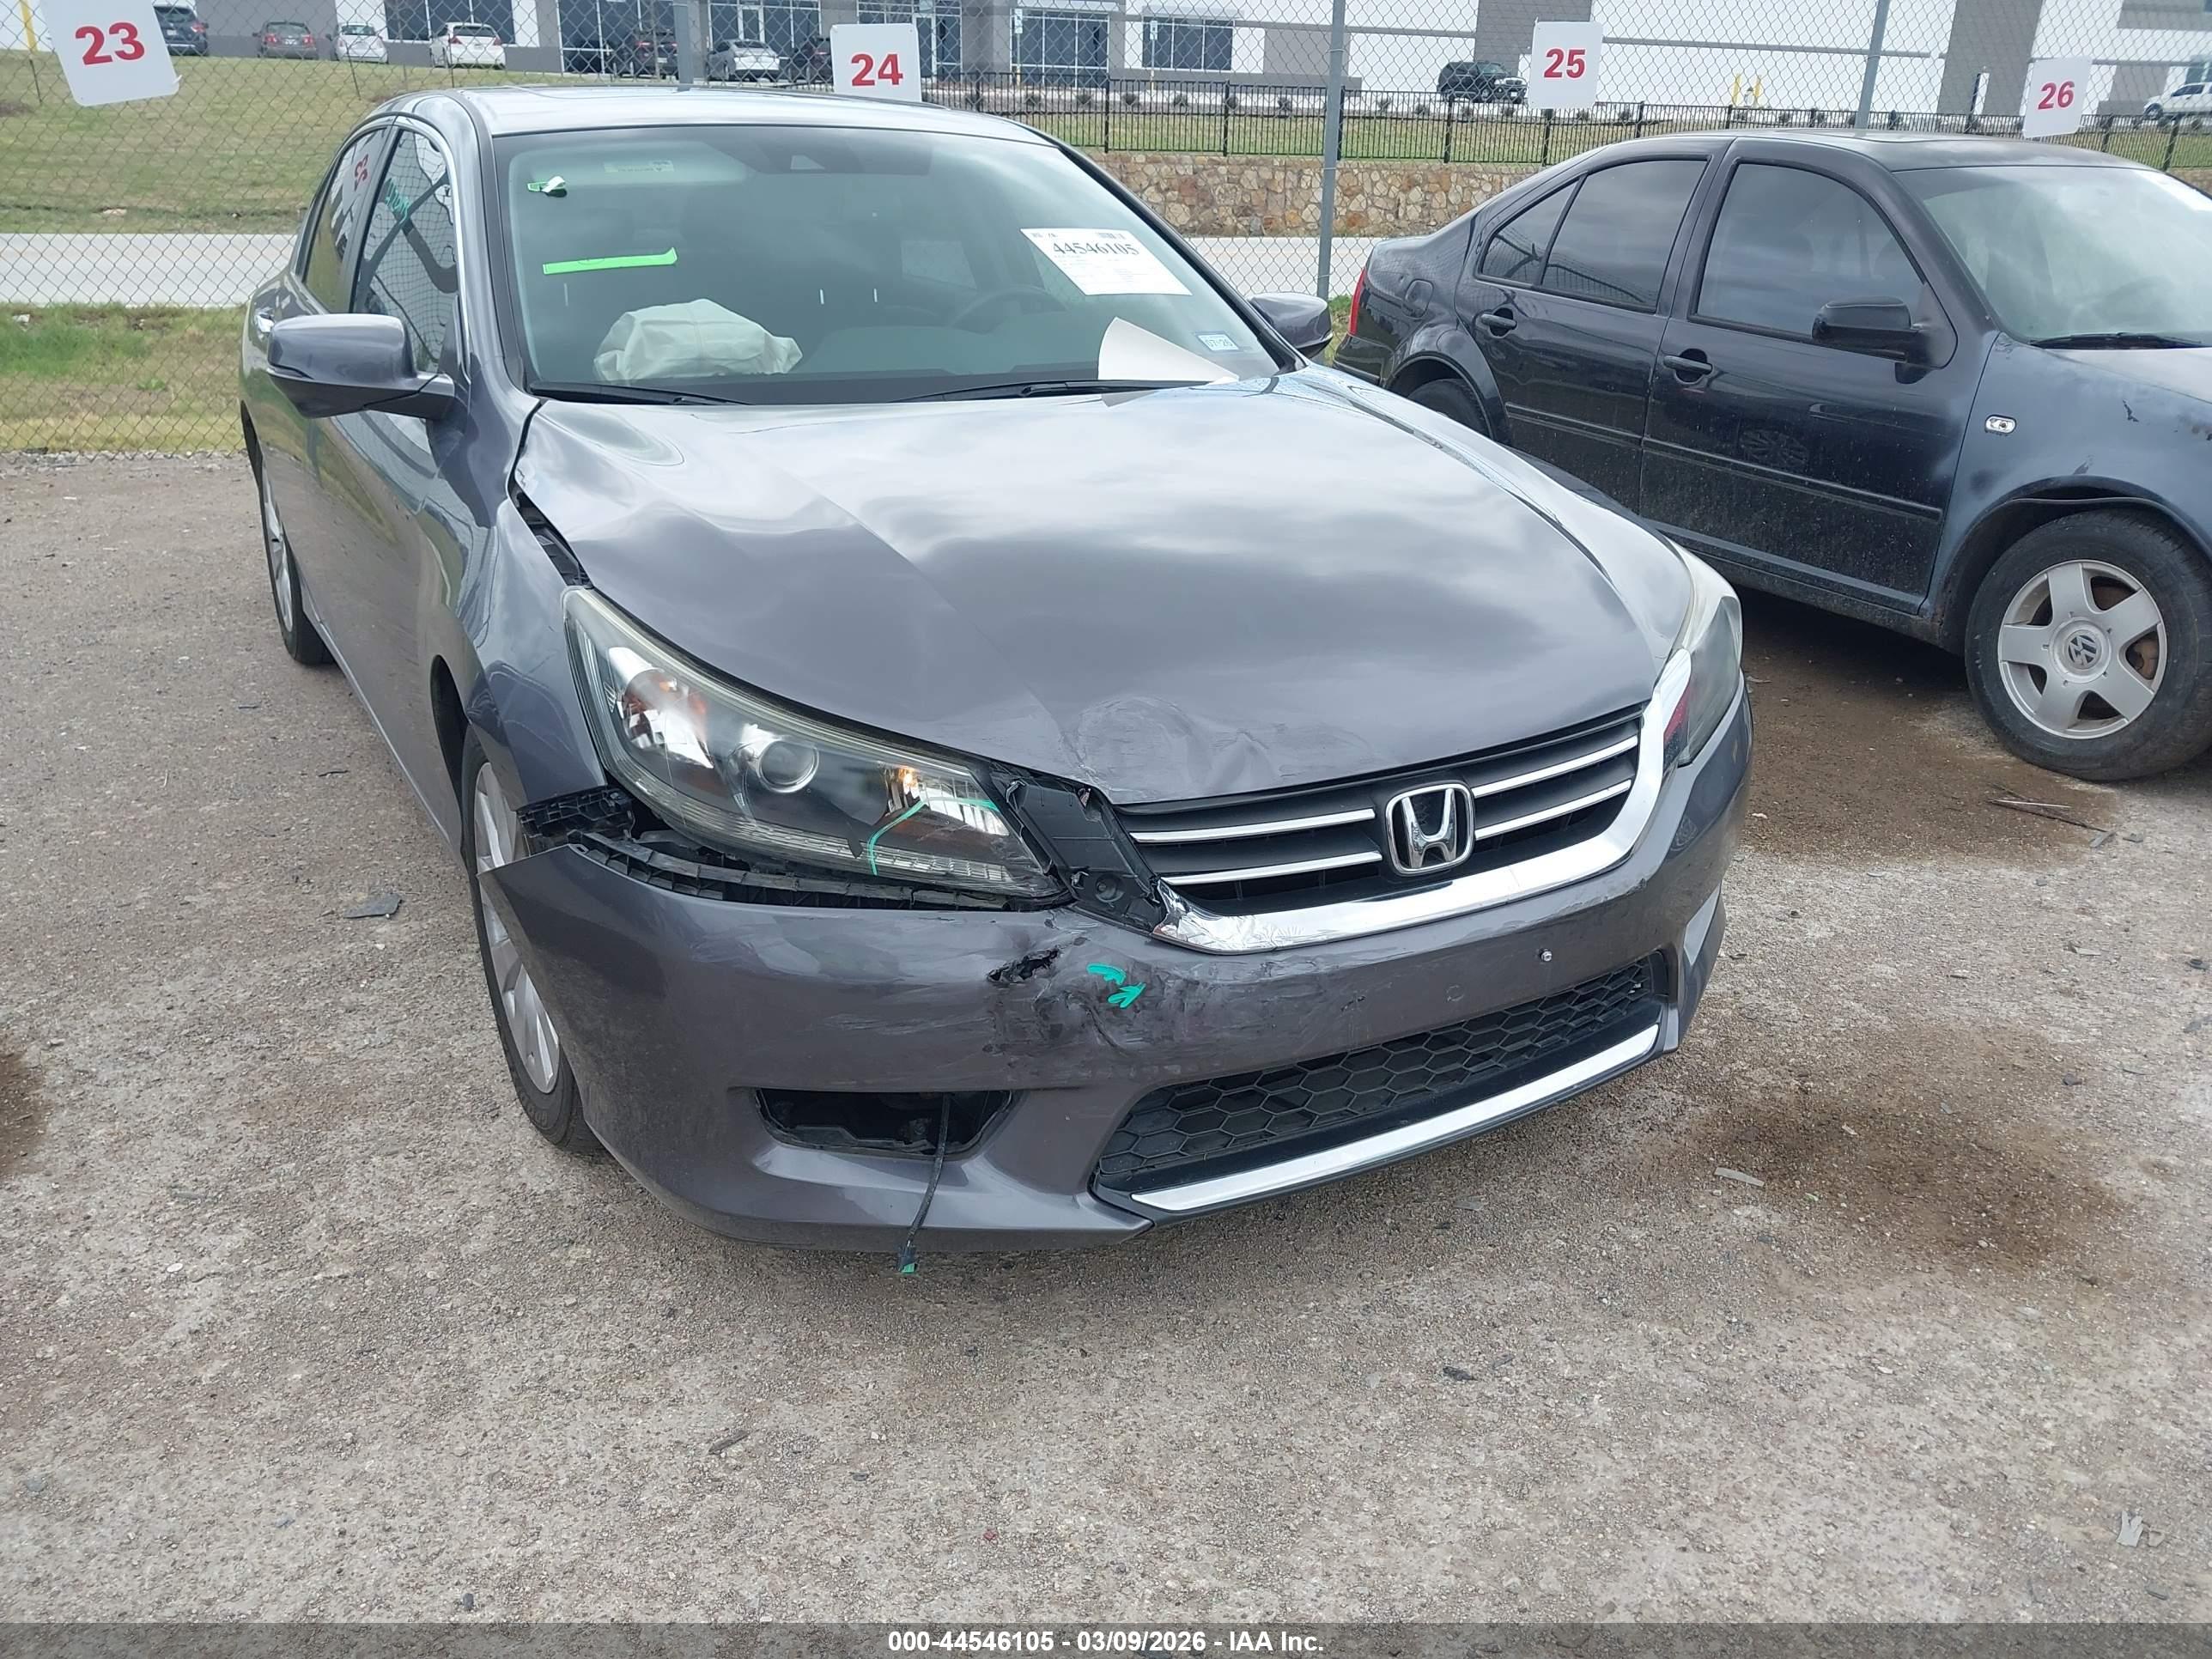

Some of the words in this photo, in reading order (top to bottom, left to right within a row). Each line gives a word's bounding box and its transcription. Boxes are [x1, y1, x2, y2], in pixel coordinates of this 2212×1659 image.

[75, 21, 145, 66] 23
[851, 53, 902, 87] 24
[1543, 48, 1585, 79] 25
[2038, 82, 2075, 110] 26
[1053, 242, 1140, 255] 44546105
